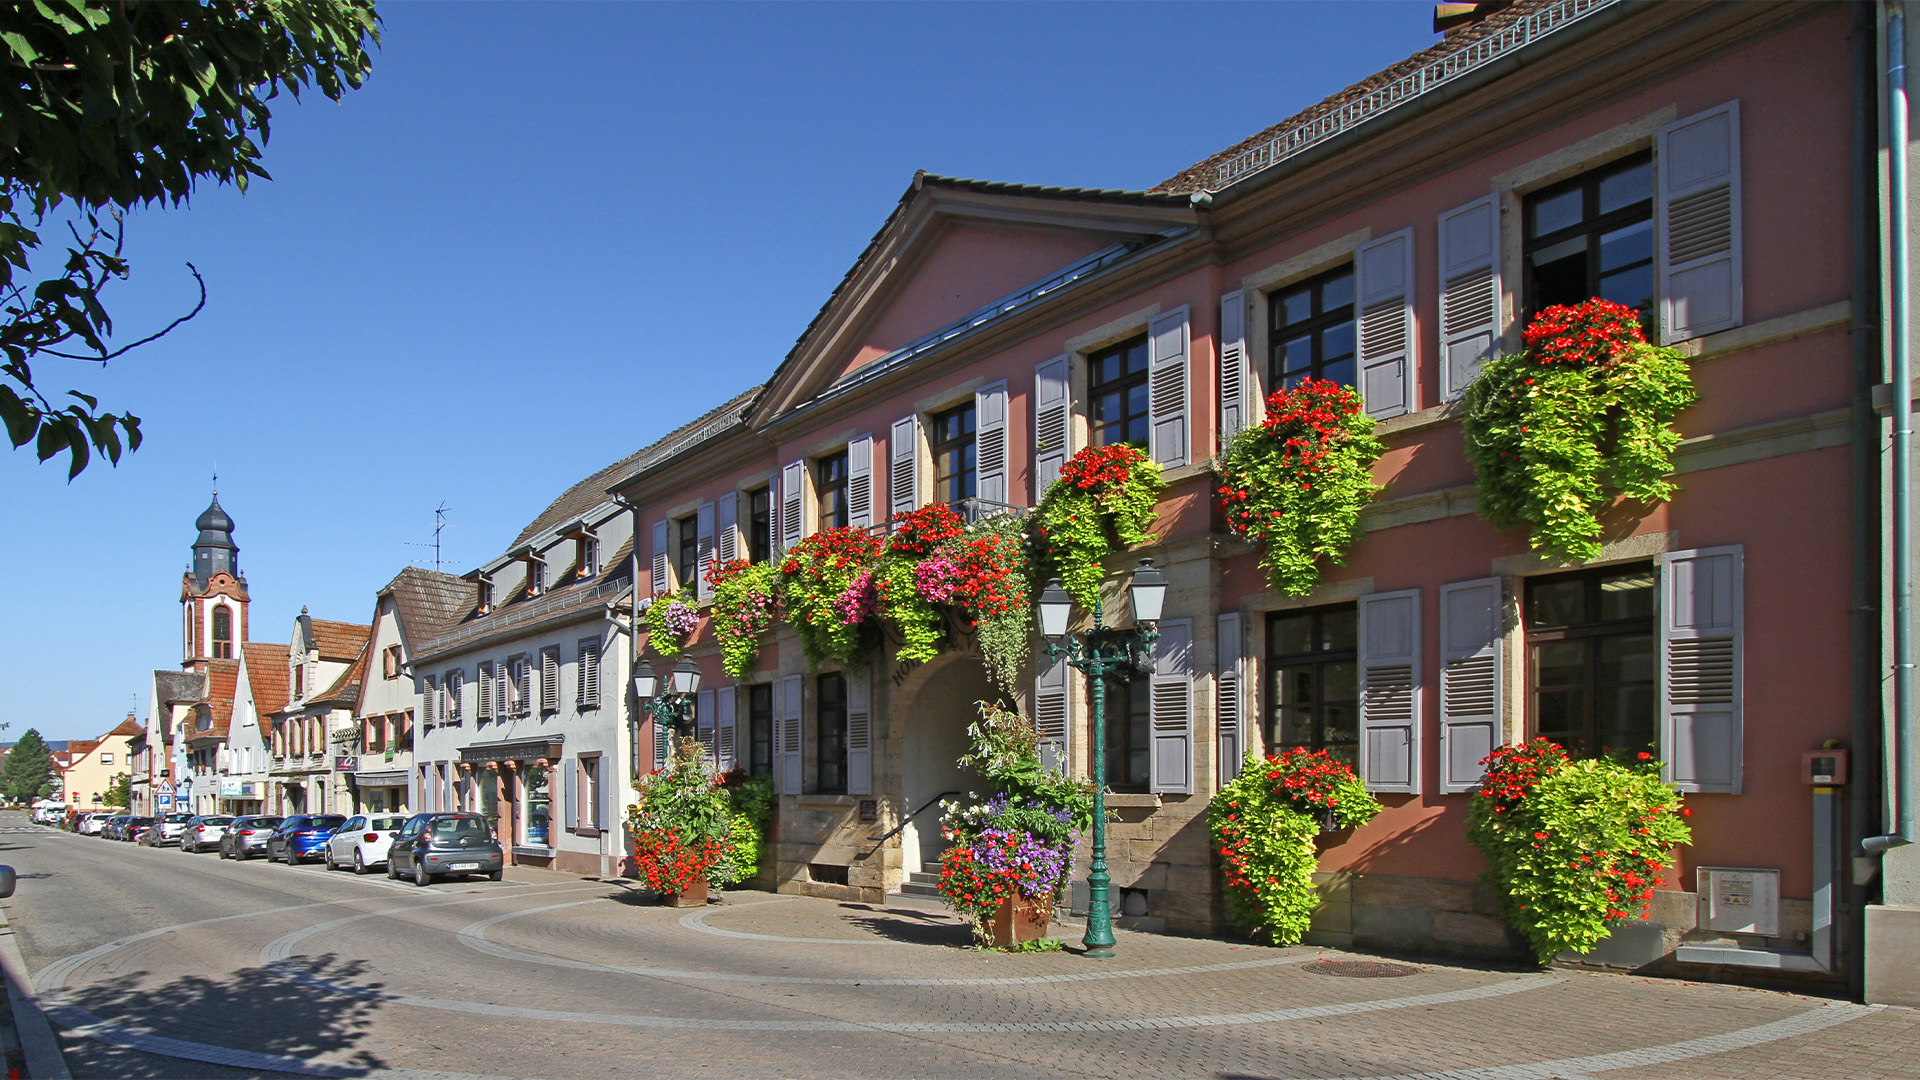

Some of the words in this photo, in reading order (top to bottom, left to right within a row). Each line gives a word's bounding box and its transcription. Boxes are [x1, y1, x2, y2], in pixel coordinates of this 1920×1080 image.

[464, 751, 488, 761] OFFICE
[491, 751, 501, 760] DU
[504, 747, 545, 759] TOURISME
